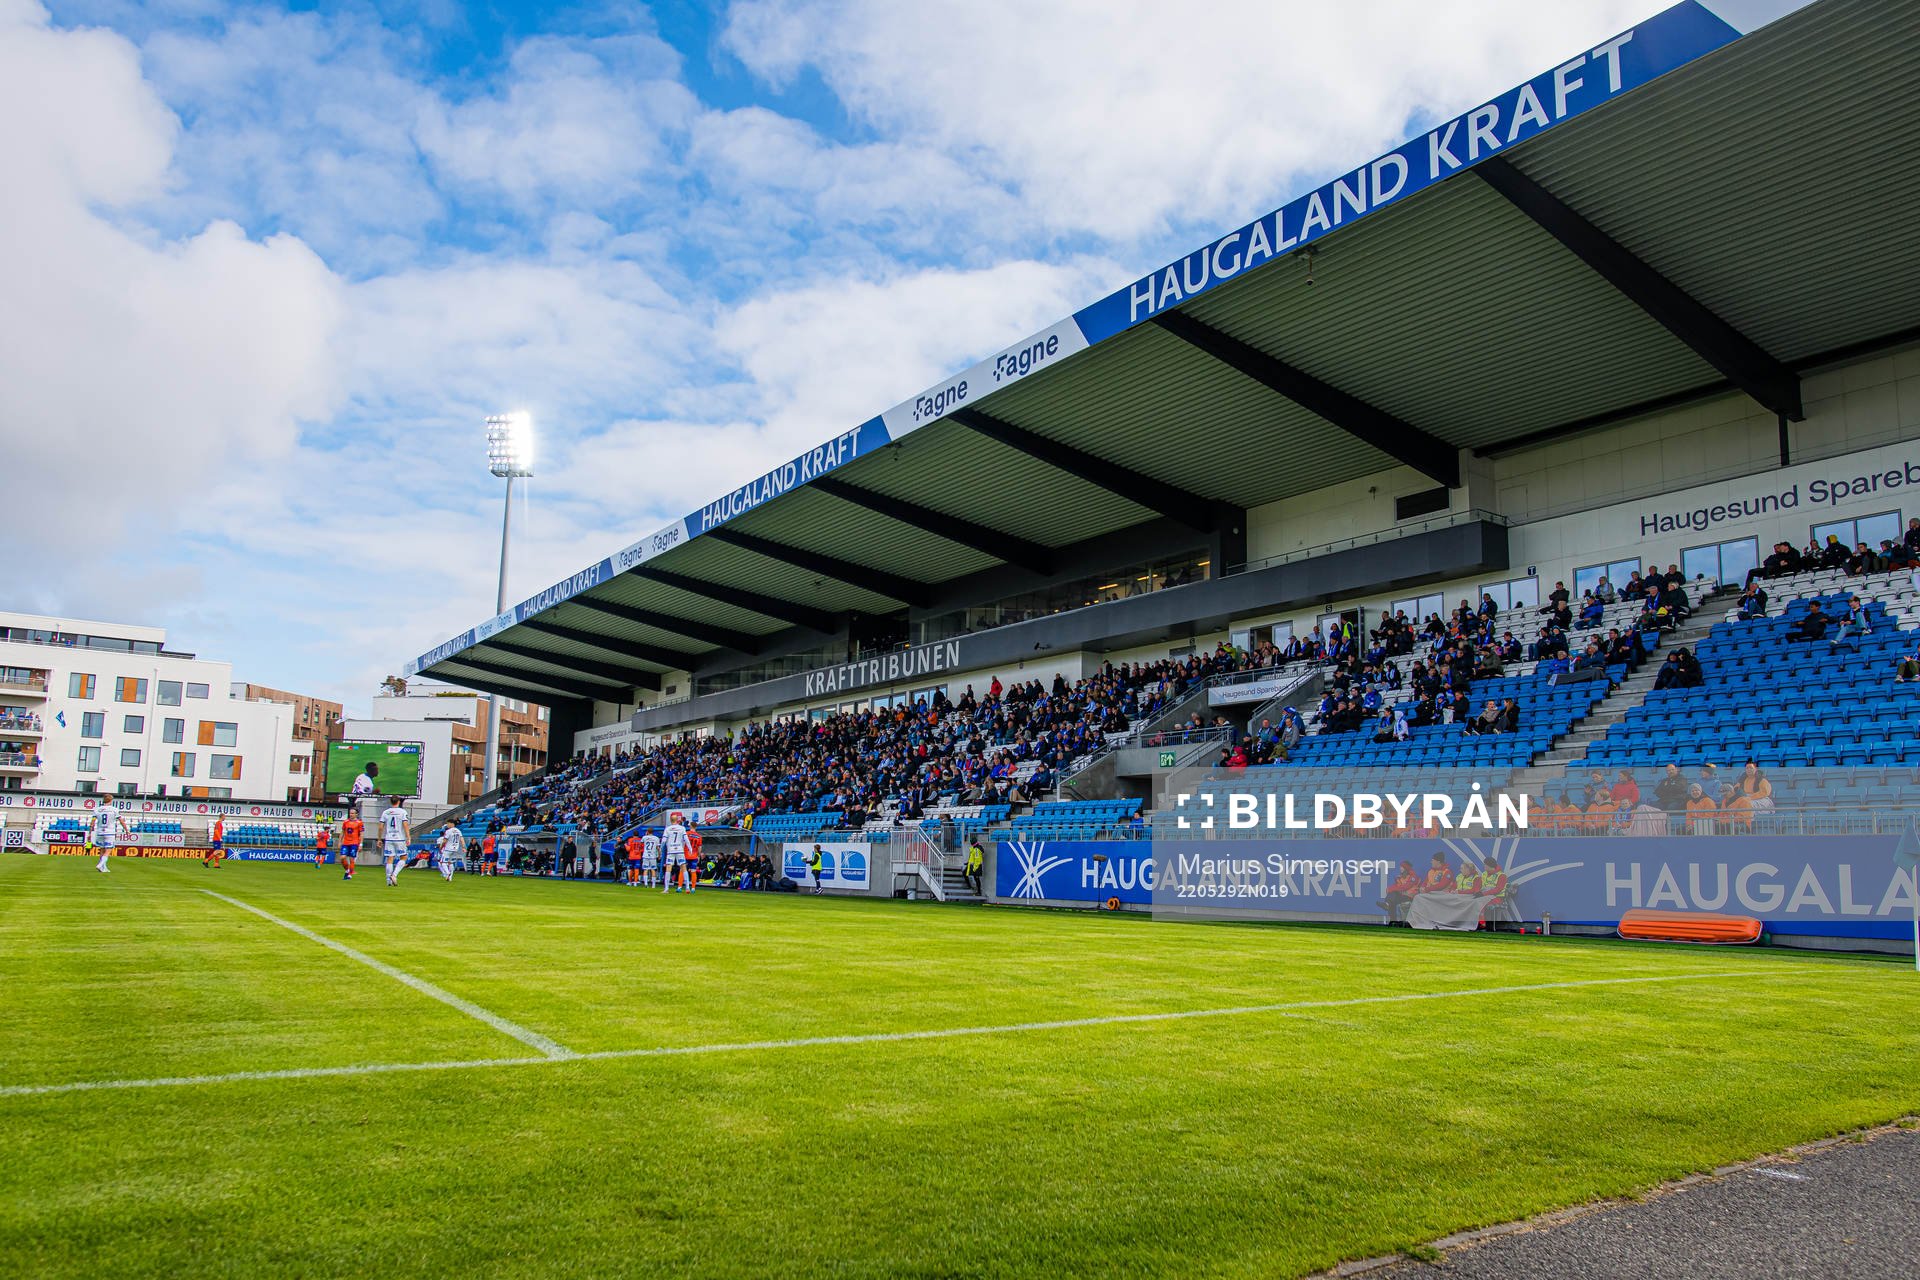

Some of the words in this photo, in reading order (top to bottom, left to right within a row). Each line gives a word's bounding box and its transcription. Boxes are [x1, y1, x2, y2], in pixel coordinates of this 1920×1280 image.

[1130, 153, 1408, 322] HAUGALAND
[1428, 30, 1634, 177] KRAFT
[993, 333, 1059, 381] Fagne
[912, 380, 968, 421] Fagne
[701, 462, 797, 531] HAUGALAND
[800, 426, 862, 483] KRAFT
[1640, 484, 1799, 536] Haugesund
[652, 528, 679, 552] Fagne
[523, 579, 571, 618] HAUGALAND
[572, 563, 602, 594] KRAFT
[805, 640, 961, 697] KRAFTTRIBUNEN
[1222, 687, 1256, 698] Haugesund
[39, 797, 73, 808] HAUBO
[98, 800, 132, 811] HUBO
[156, 803, 188, 813] HAUBO
[211, 805, 241, 815] HAUBO
[264, 807, 293, 817] HAUBO
[101, 814, 108, 825] 8
[390, 816, 397, 829] 4
[159, 834, 183, 843] HBO
[672, 832, 678, 843] 7
[645, 841, 655, 850] 27
[143, 848, 206, 859] PIZZABAKEREN
[249, 852, 302, 861] HAUGALAND
[1082, 857, 1267, 897] HAUGALAND
[1275, 860, 1396, 899] KRAFT
